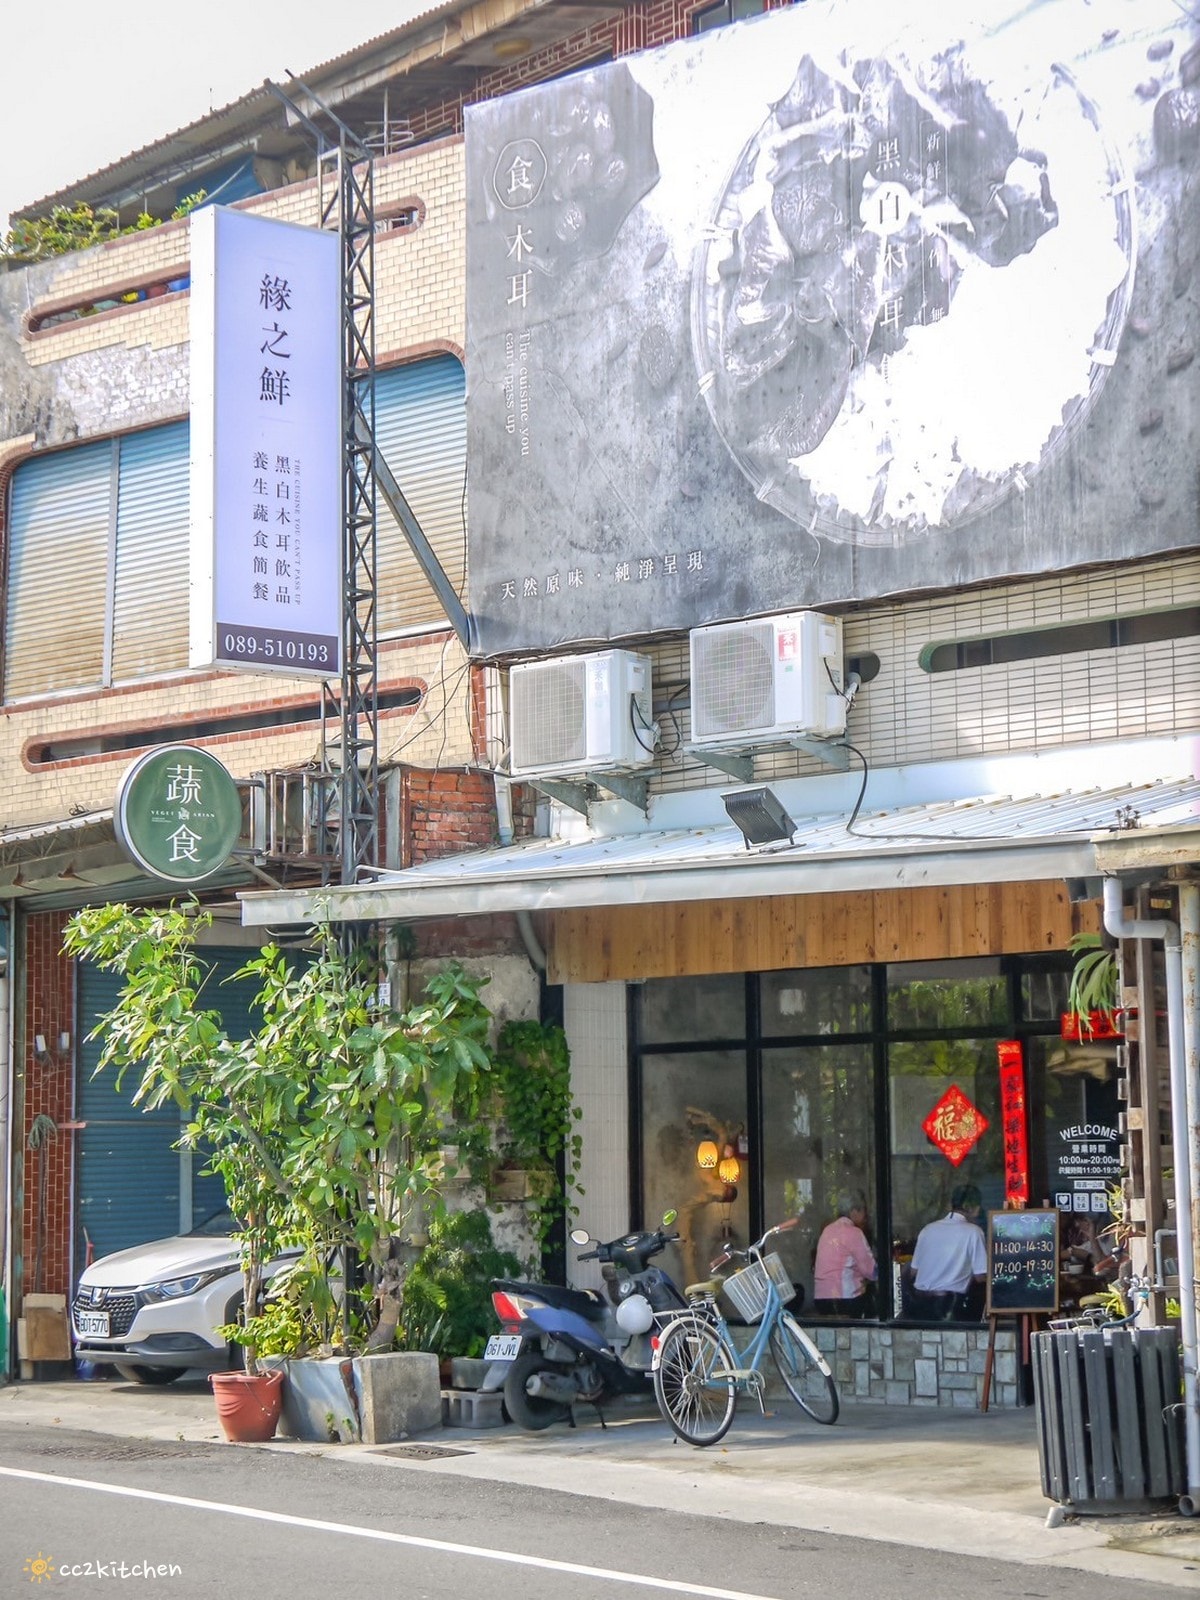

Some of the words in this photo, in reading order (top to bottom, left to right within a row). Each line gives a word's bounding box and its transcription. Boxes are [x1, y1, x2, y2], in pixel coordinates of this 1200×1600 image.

[259, 273, 292, 406] 緣之鮮
[520, 329, 531, 361] The
[504, 374, 515, 409] pass
[520, 367, 531, 421] cuisine
[505, 415, 515, 434] up
[520, 428, 529, 456] you
[253, 451, 269, 601] 養生蔬食簡餐
[275, 455, 291, 604] 黑白木耳飲品
[294, 594, 302, 606] UP
[225, 634, 328, 663] 089-510193
[166, 764, 203, 862] 蔬食
[933, 1105, 957, 1141] 福
[1060, 1124, 1118, 1141] WELCOME
[995, 1240, 1054, 1255] 11:00-14:30
[995, 1259, 1054, 1274] 17:00-19:30
